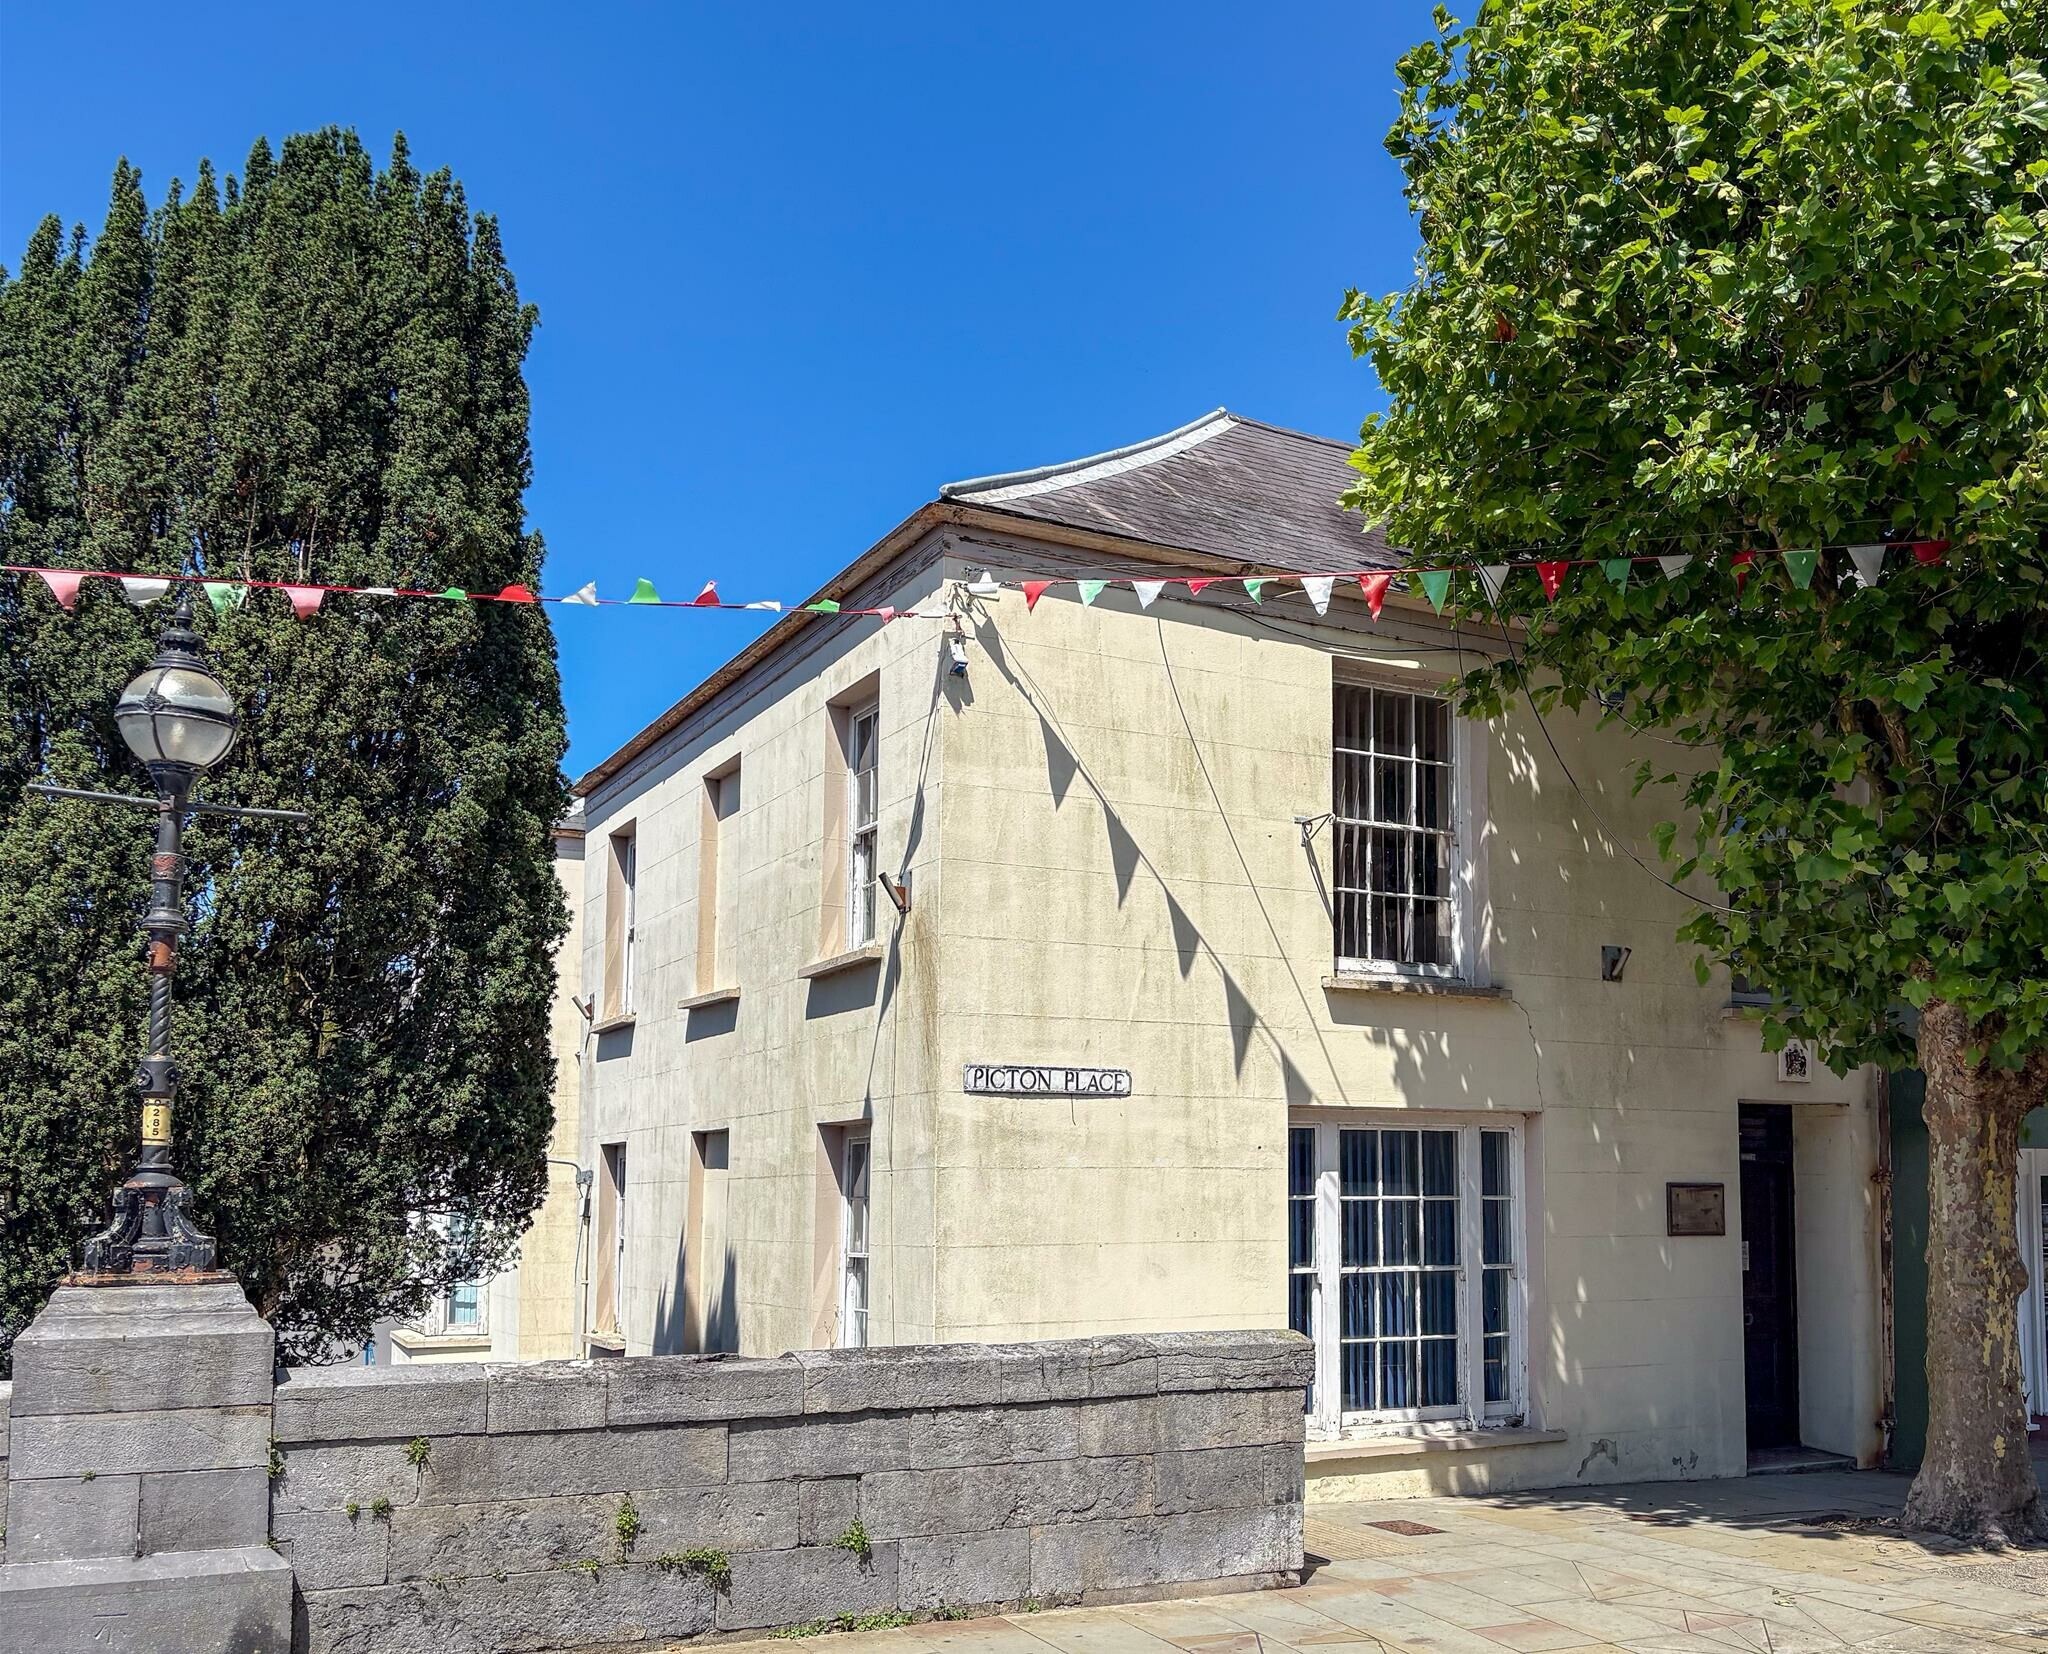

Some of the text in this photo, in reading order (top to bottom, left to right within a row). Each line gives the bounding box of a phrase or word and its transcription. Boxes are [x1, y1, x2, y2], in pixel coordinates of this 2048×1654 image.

[973, 1068, 1125, 1091] PICTON PLACE
[152, 1108, 160, 1136] 285
